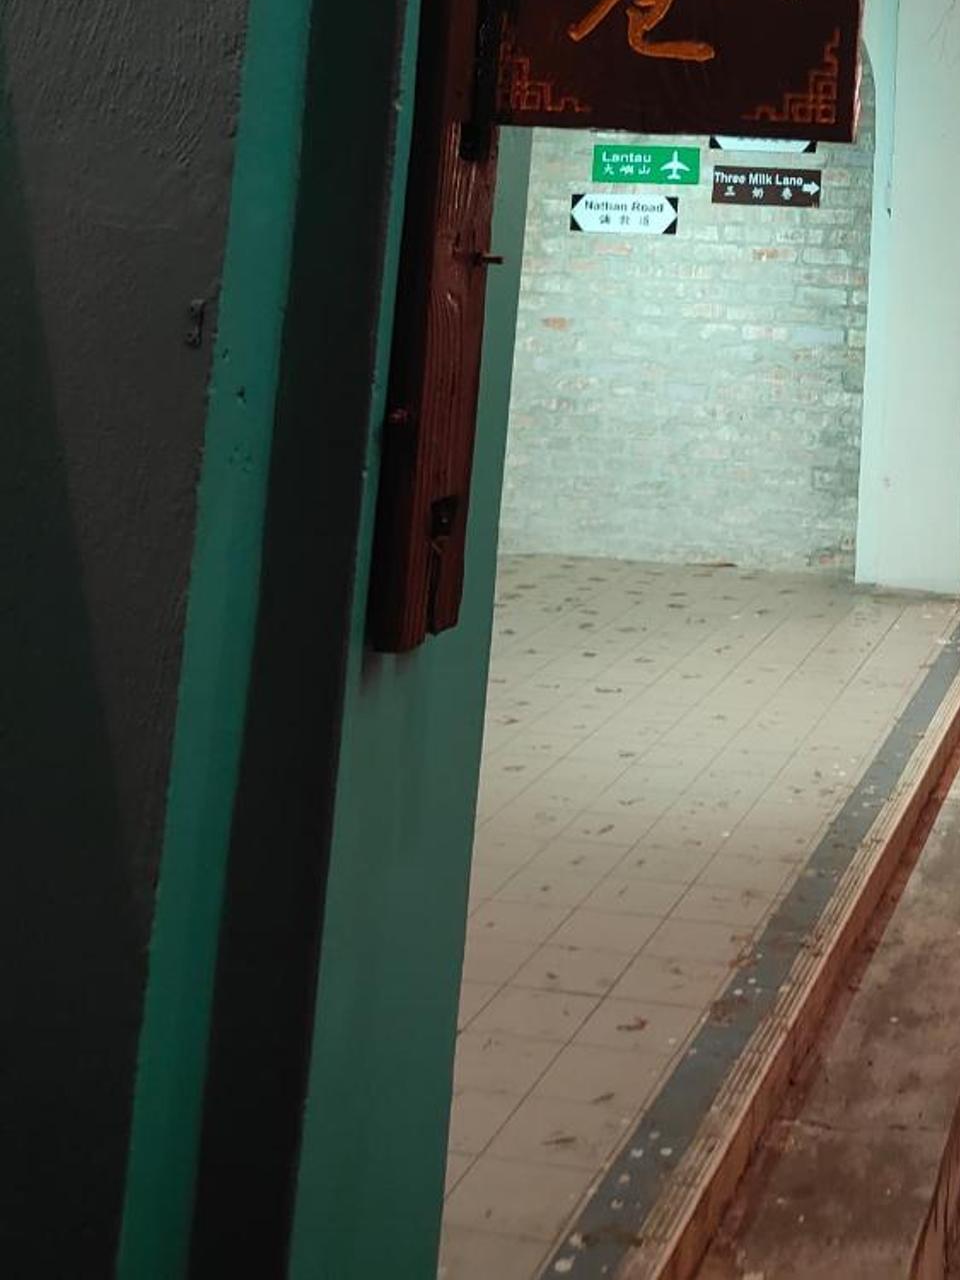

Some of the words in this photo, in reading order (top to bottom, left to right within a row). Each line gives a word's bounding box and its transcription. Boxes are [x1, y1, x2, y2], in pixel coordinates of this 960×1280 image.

[602, 151, 652, 164] Lantau
[714, 171, 746, 185] Three
[748, 173, 773, 186] Milk
[775, 174, 804, 186] Lane
[584, 199, 628, 212] Nathan
[630, 201, 665, 214] Road
